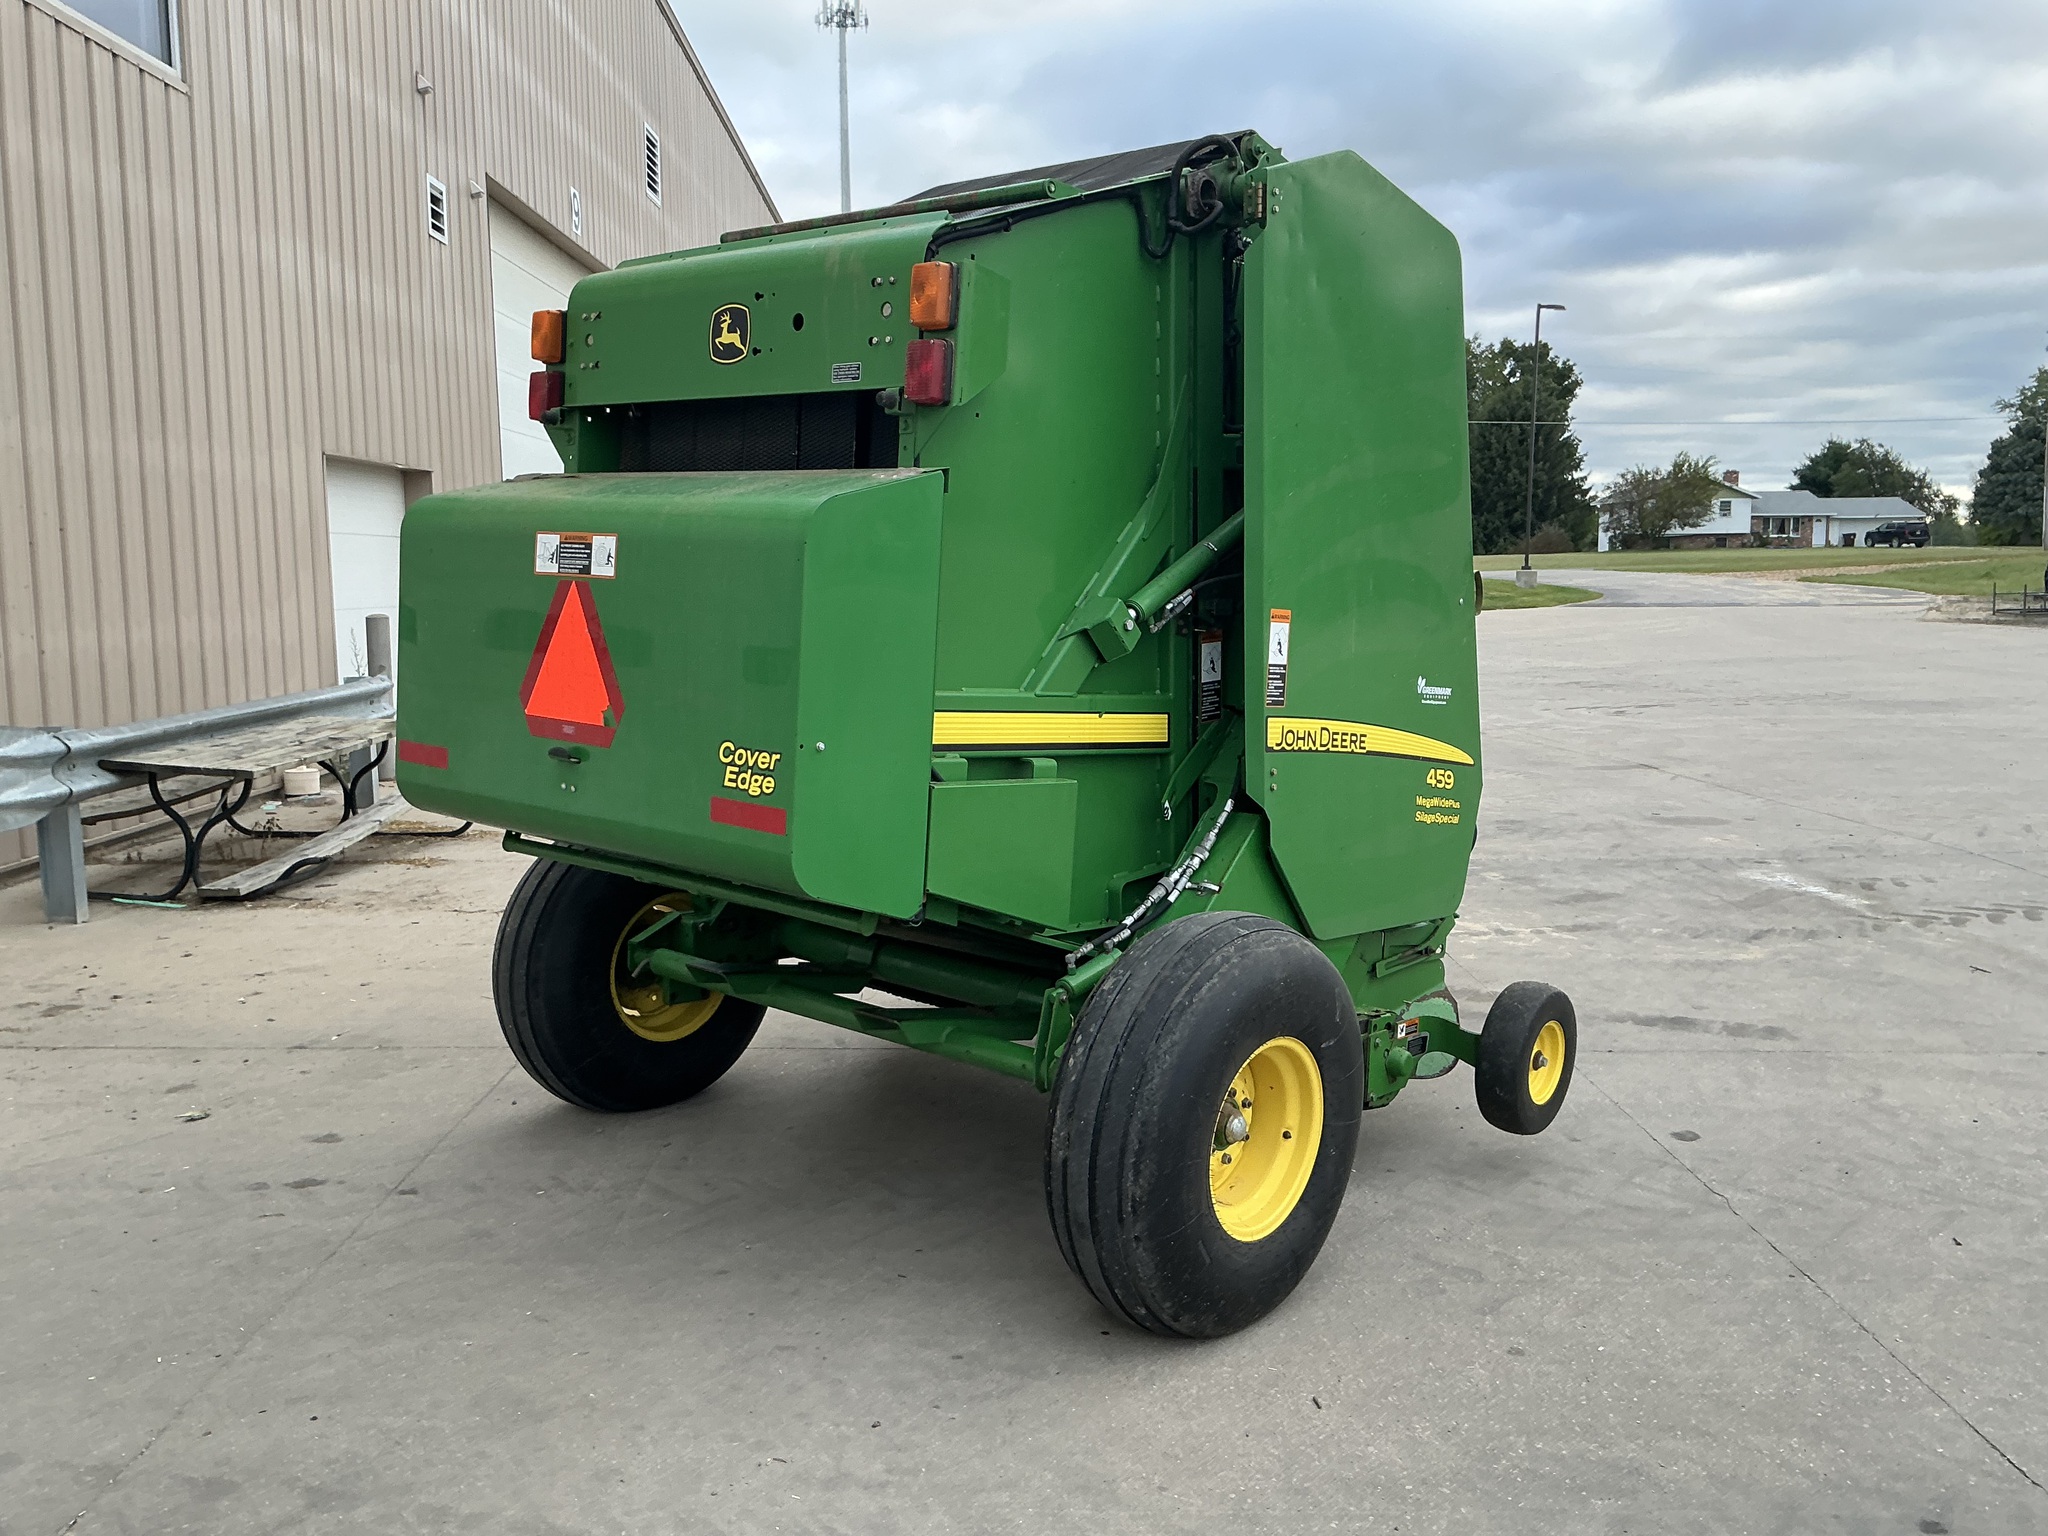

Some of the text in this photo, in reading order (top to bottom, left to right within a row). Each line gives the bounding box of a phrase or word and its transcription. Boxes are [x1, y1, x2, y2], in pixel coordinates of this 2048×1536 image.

[572, 191, 580, 232] 9
[718, 740, 782, 771] Cover
[722, 764, 776, 797] Edge
[1426, 768, 1455, 790] 459
[1414, 810, 1461, 825] SilageSpecial
